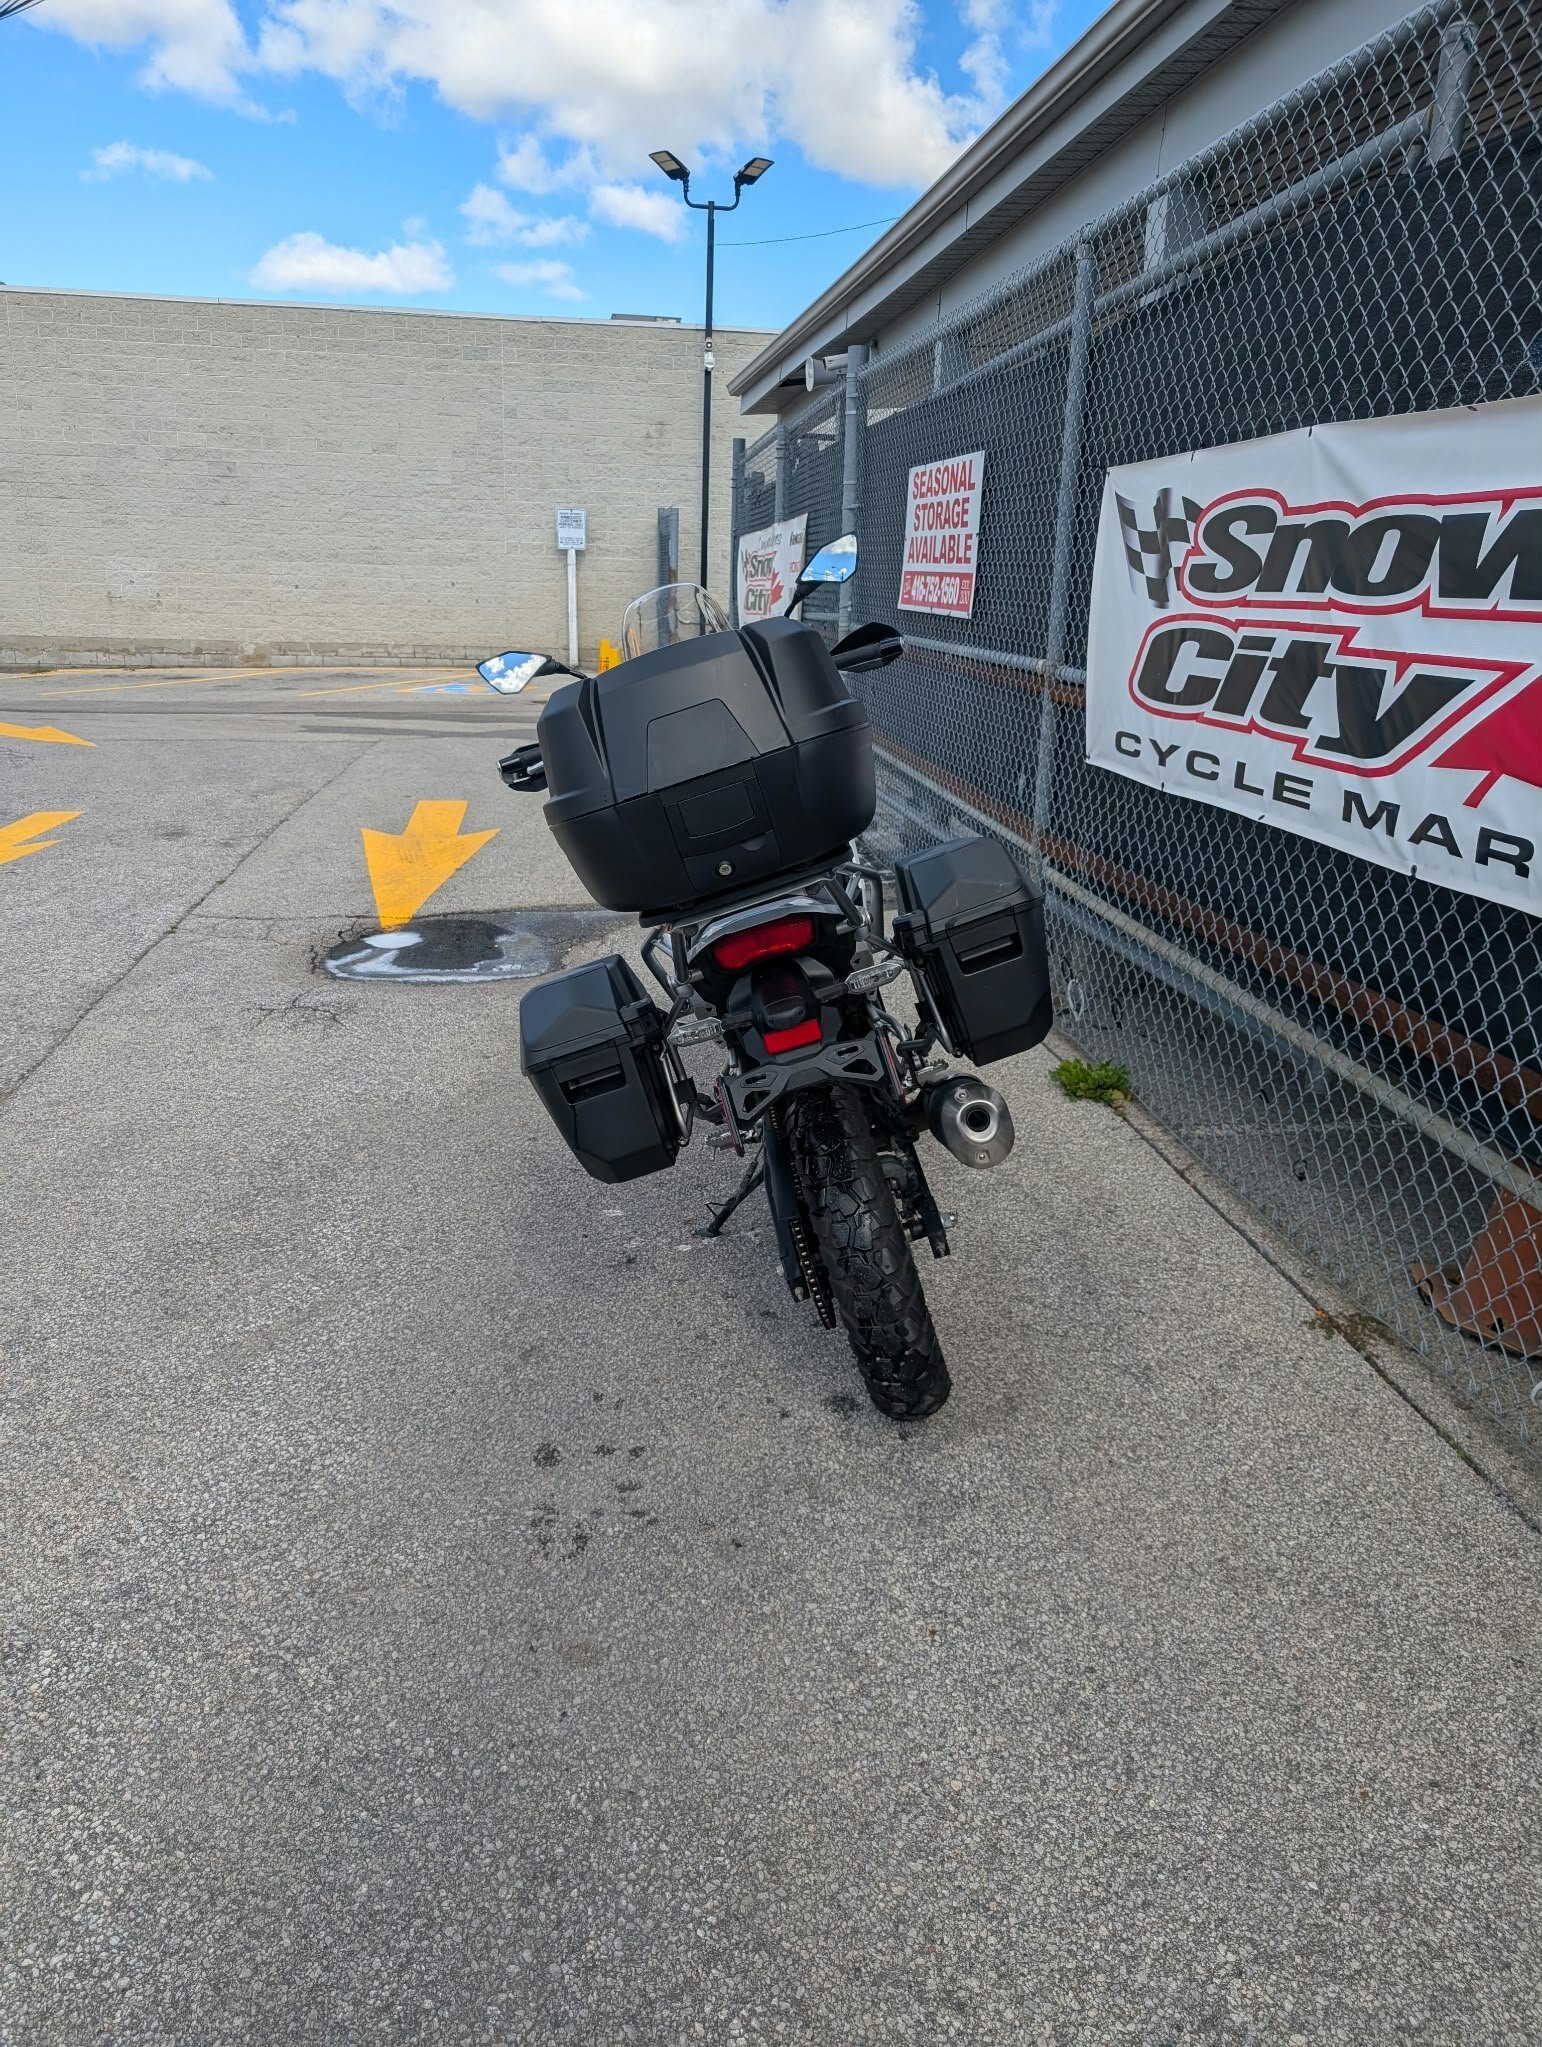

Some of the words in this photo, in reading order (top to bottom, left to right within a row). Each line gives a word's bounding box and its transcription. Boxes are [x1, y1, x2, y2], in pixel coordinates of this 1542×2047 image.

[913, 459, 975, 499] SEASONAL
[914, 496, 970, 531] STORAGE
[908, 533, 973, 564] AVAILABLE
[744, 588, 770, 615] City
[911, 574, 960, 605] 416-752-1560
[1137, 626, 1476, 760] City
[1114, 730, 1314, 811] CYCLE
